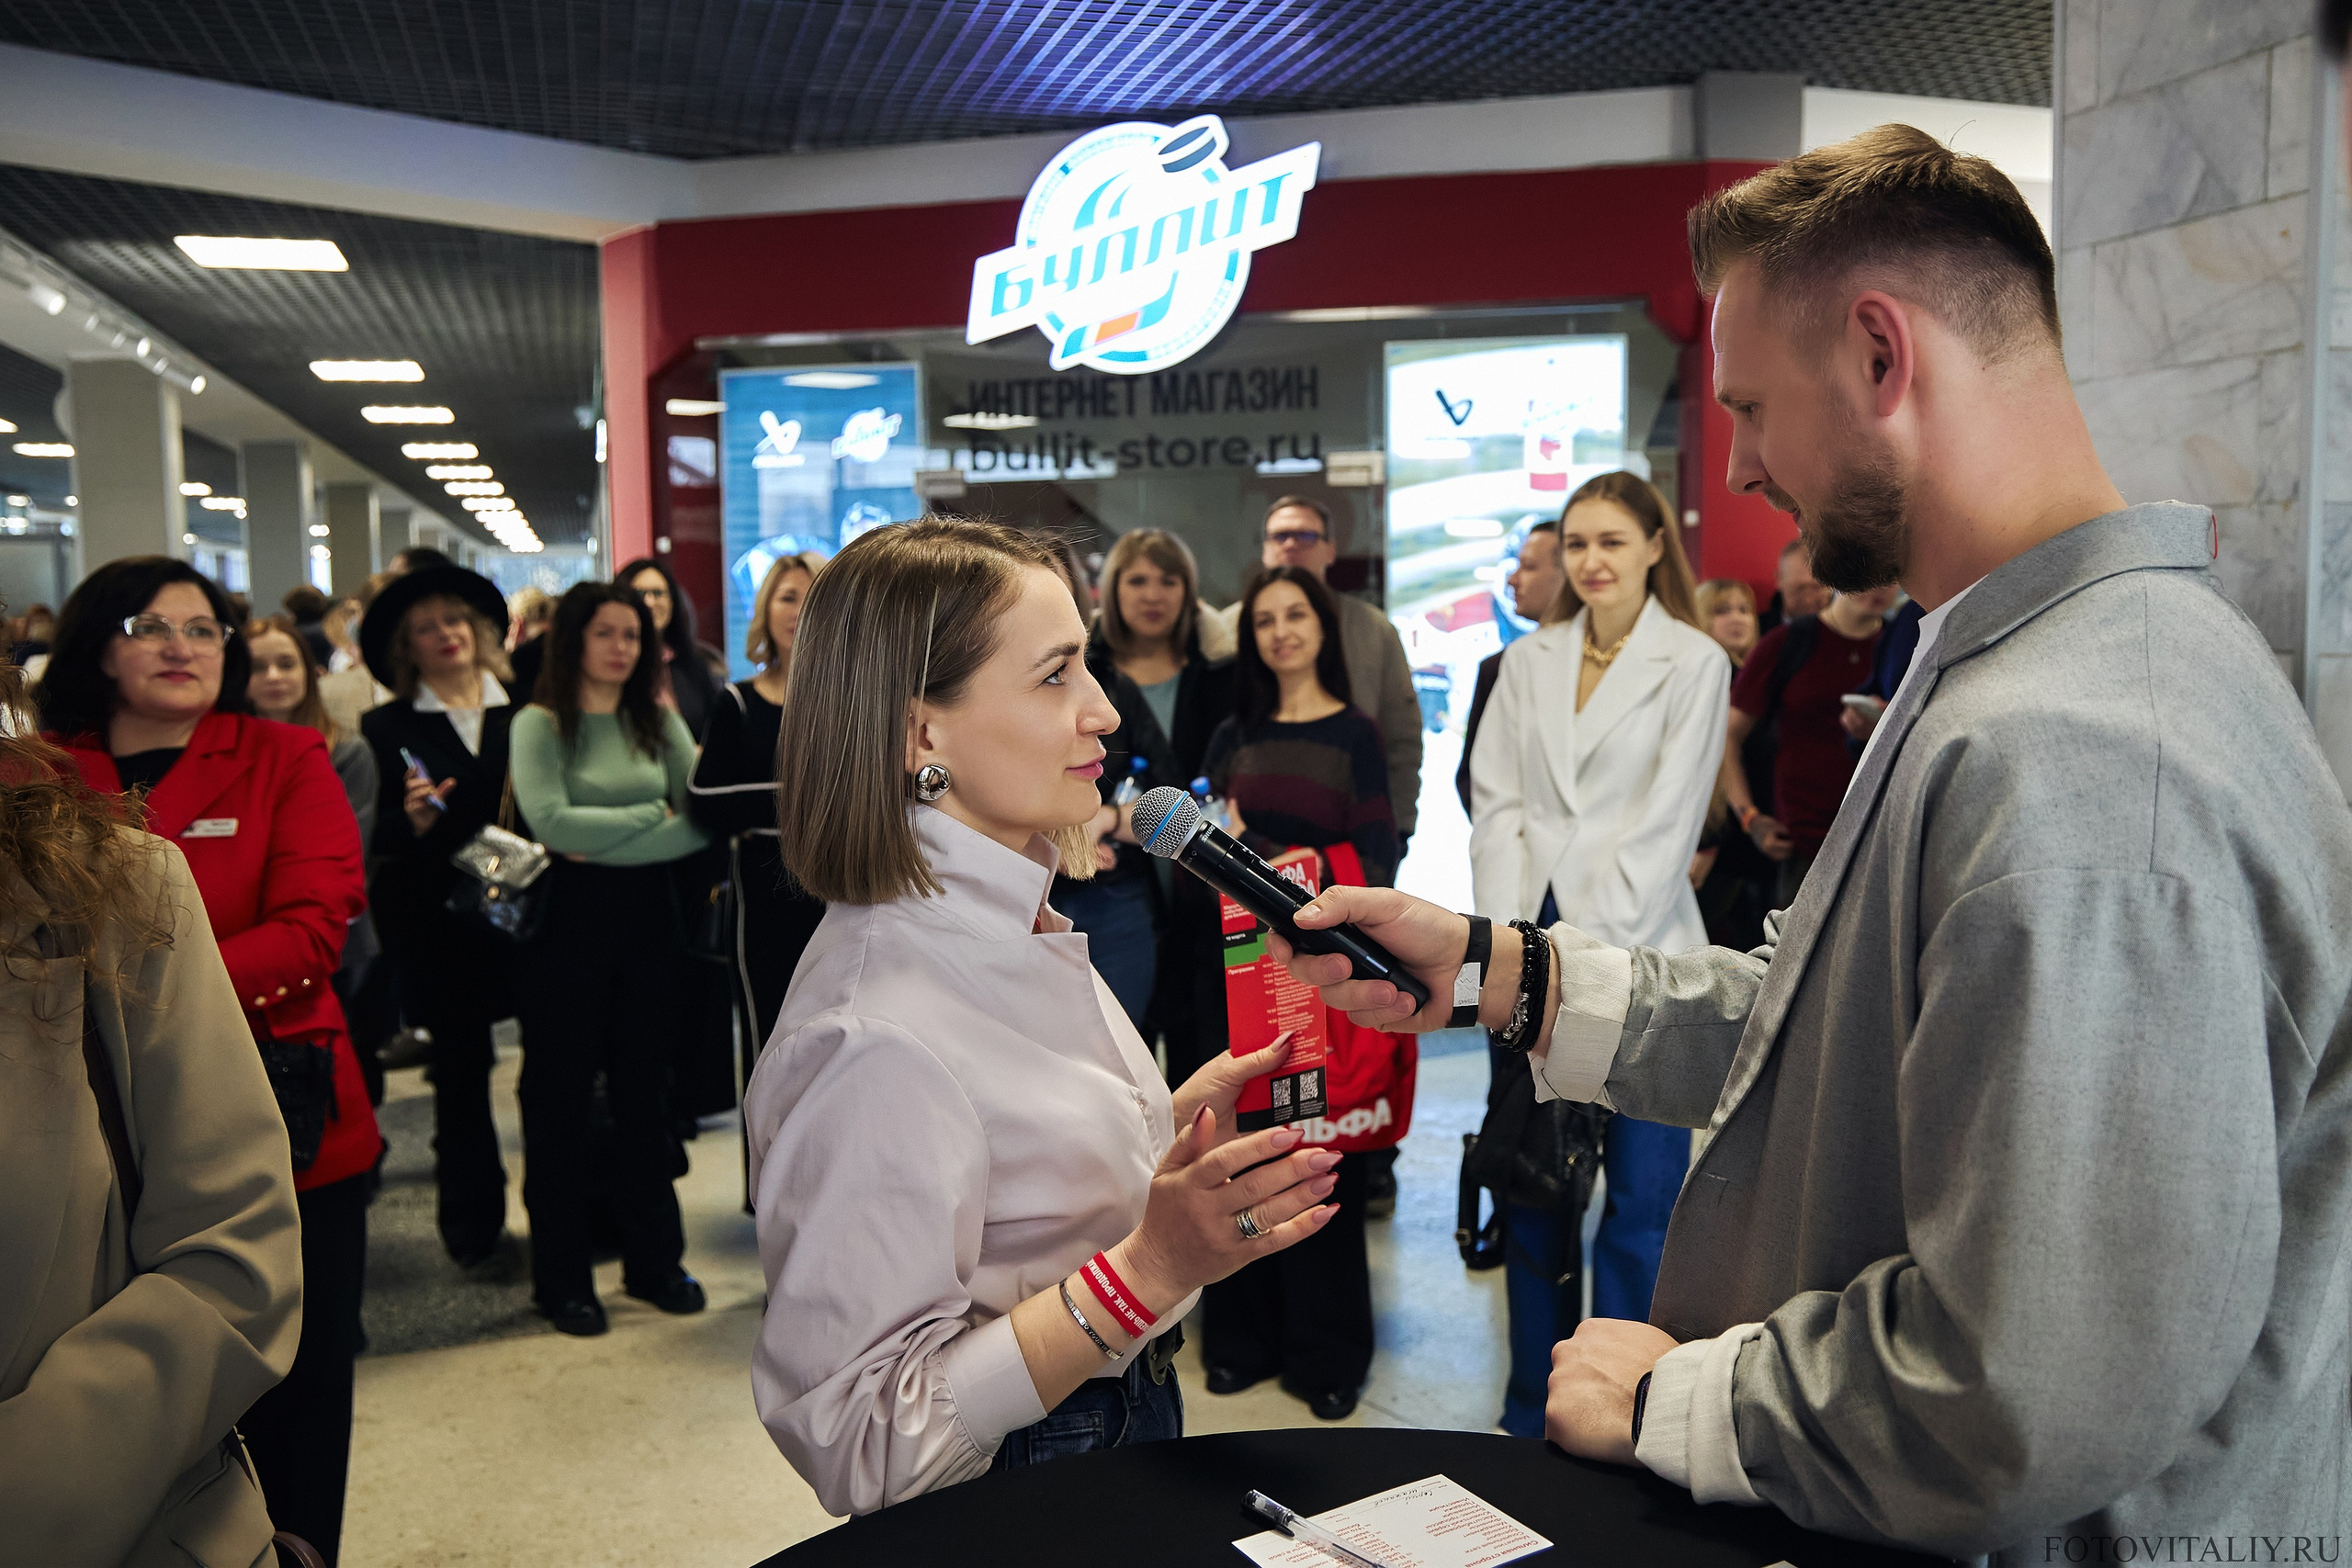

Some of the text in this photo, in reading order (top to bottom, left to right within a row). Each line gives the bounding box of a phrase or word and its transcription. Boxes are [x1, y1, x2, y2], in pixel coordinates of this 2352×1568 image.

[968, 367, 1318, 418] ИНТЕРНЕТ МАГАЗИН
[1124, 1308, 1136, 1320] НЕ
[1493, 1535, 1530, 1549] Маркетинг
[1499, 1540, 1538, 1554] Сильная
